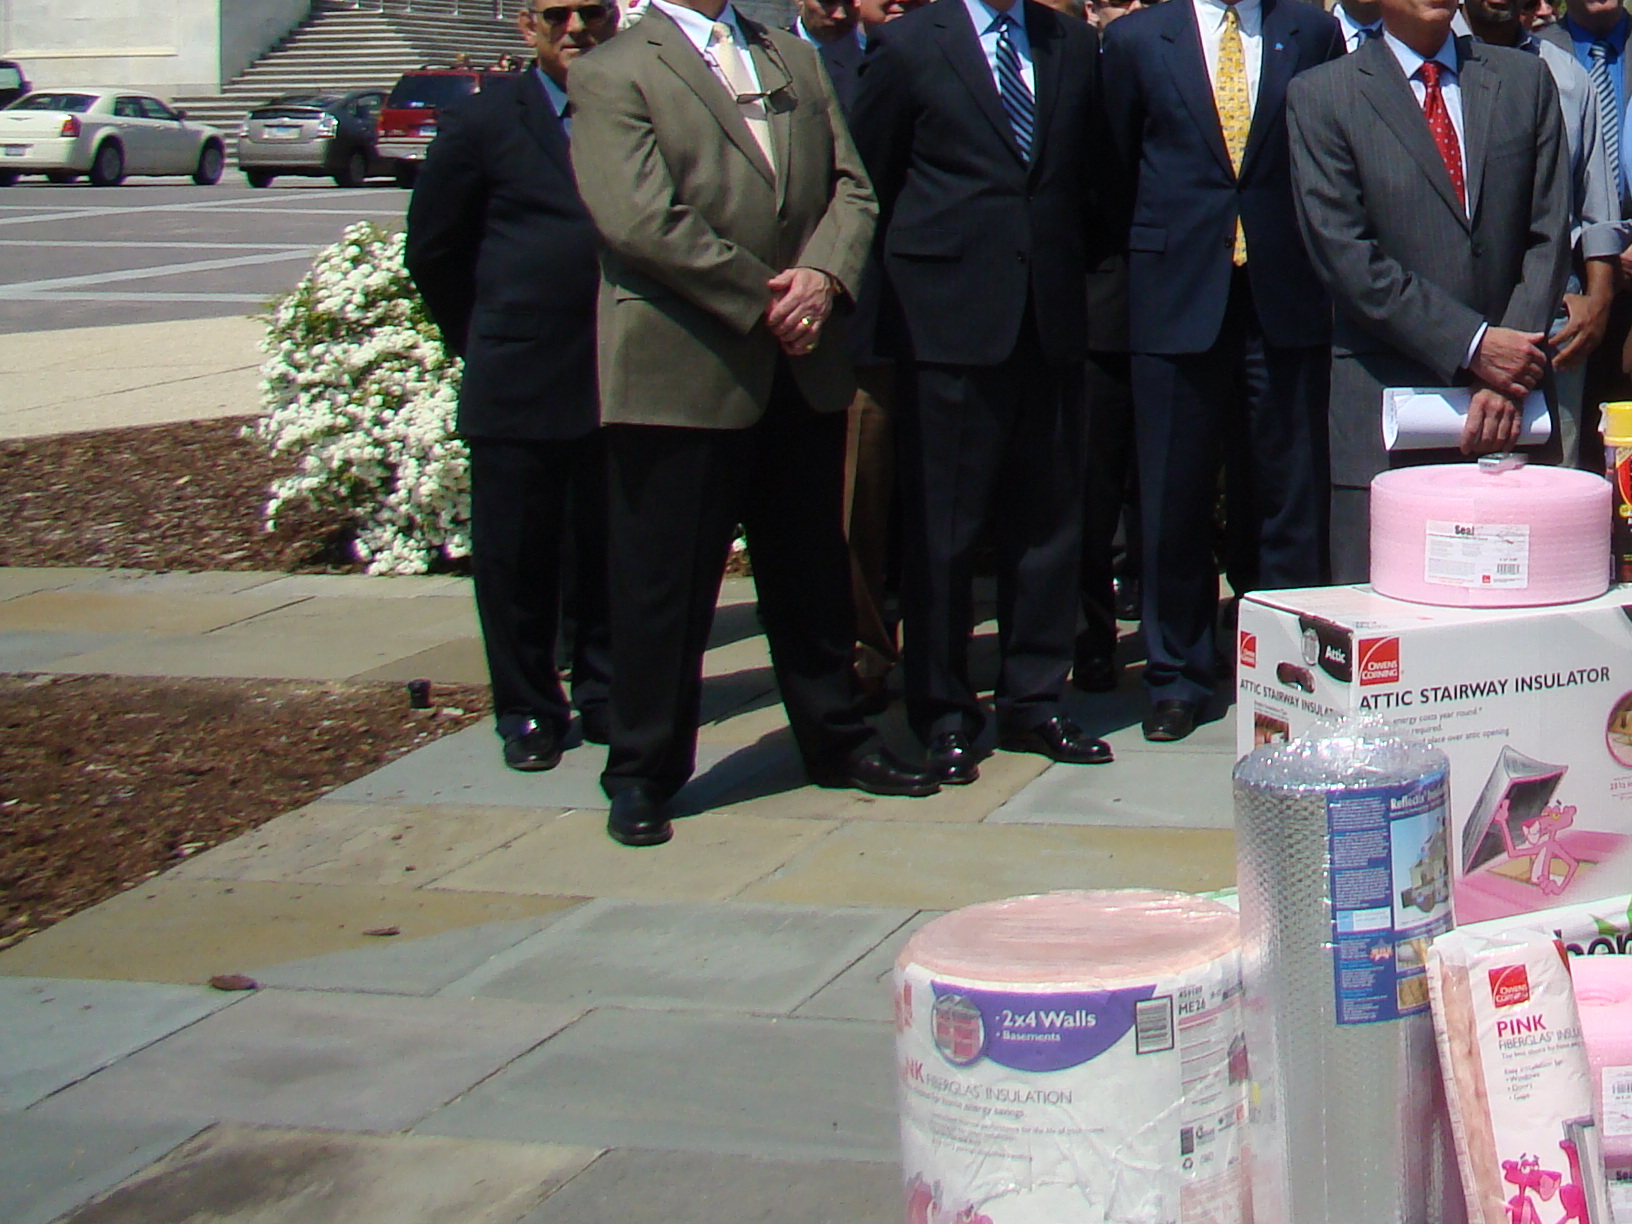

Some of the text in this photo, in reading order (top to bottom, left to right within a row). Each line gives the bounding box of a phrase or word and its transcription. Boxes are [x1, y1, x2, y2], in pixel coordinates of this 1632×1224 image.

[1455, 525, 1474, 536] Seal
[1325, 645, 1346, 664] Attic
[1367, 660, 1398, 671] OWENS
[1361, 670, 1398, 680] CORNING
[1240, 678, 1262, 695] ATTIC
[1263, 685, 1301, 709] STAIRWAY
[1359, 665, 1611, 711] ATTIC STAIRWAY INSULATOR
[1439, 711, 1455, 721] year
[1178, 997, 1207, 1015] ME26
[1001, 1009, 1096, 1028] 2x4 Walls
[1496, 1013, 1547, 1038] PINK
[1001, 1029, 1062, 1042] Basements
[985, 1087, 1073, 1105] INSULATION
